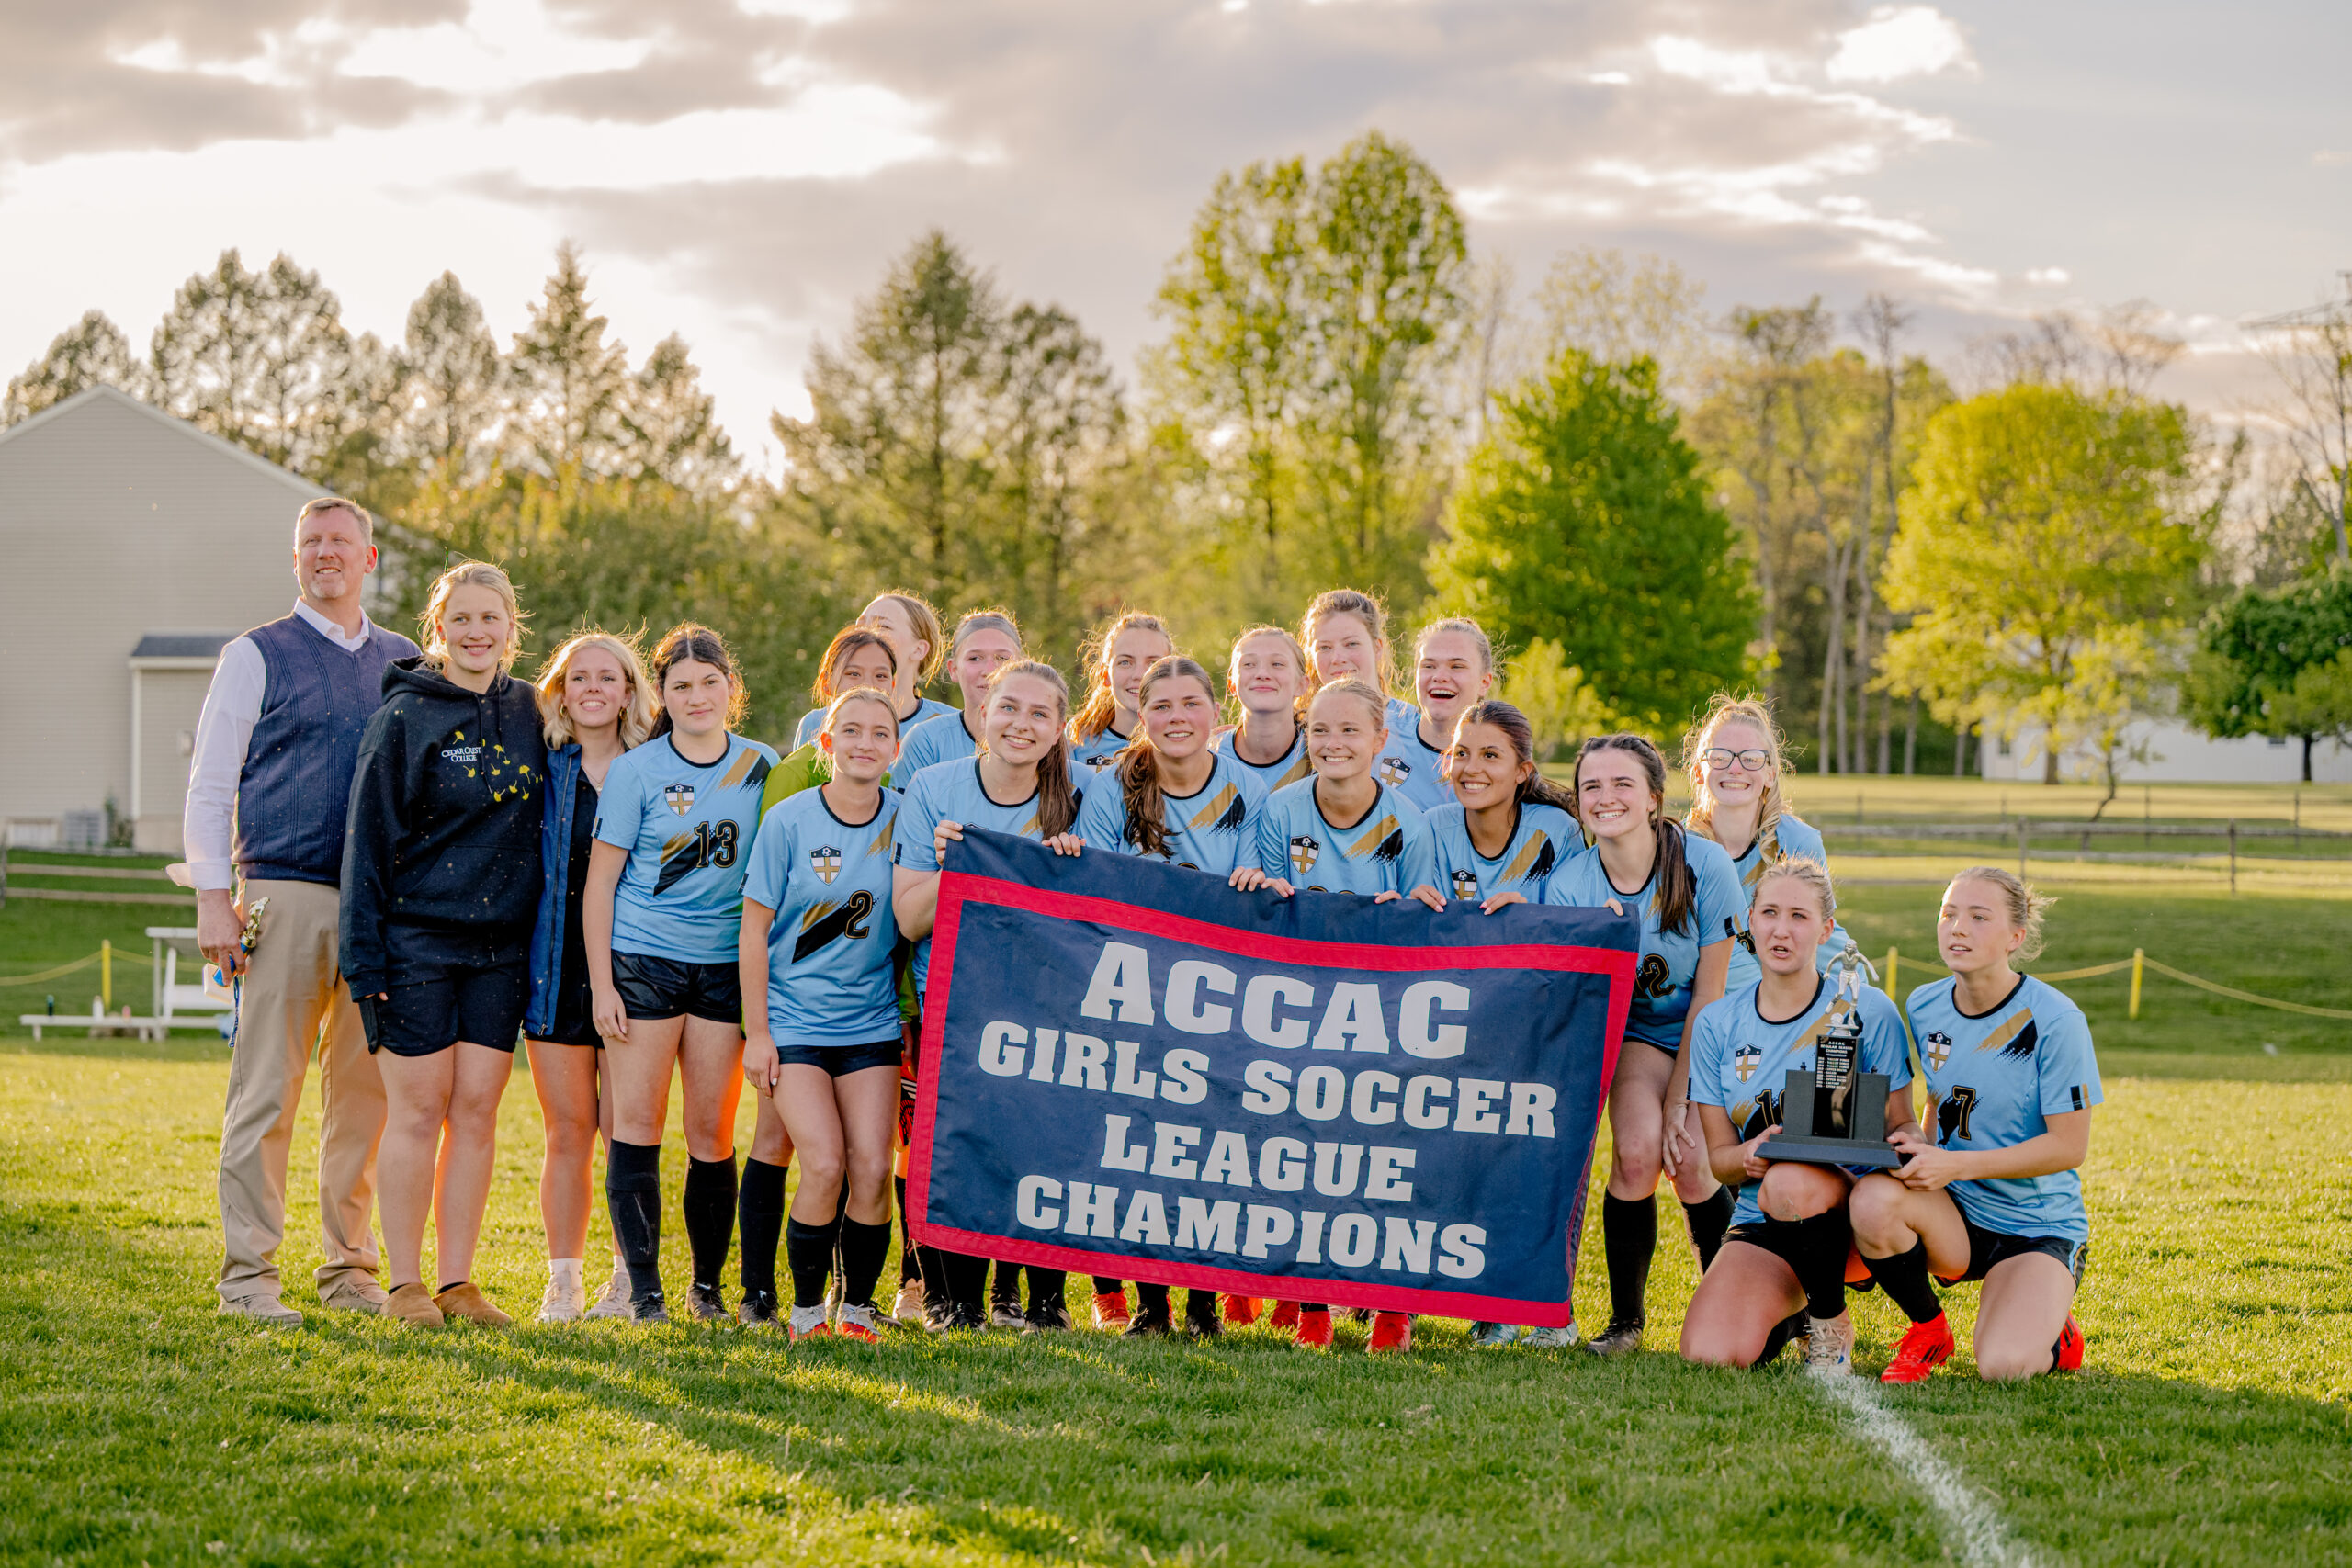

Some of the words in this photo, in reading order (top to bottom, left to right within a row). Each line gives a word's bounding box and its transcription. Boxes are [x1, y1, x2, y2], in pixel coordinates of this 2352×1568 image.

[441, 748, 464, 757] CEDAR
[450, 754, 477, 762] COLLEGE
[694, 819, 739, 868] 13
[844, 889, 874, 939] 2
[1081, 942, 1471, 1059] ACCAC
[978, 1021, 1210, 1104] GIRLS
[1241, 1060, 1557, 1139] SOCCER
[1952, 1085, 1976, 1141] 7
[1101, 1114, 1417, 1201] LEAGUE
[1016, 1175, 1487, 1279] CHAMPIONS
